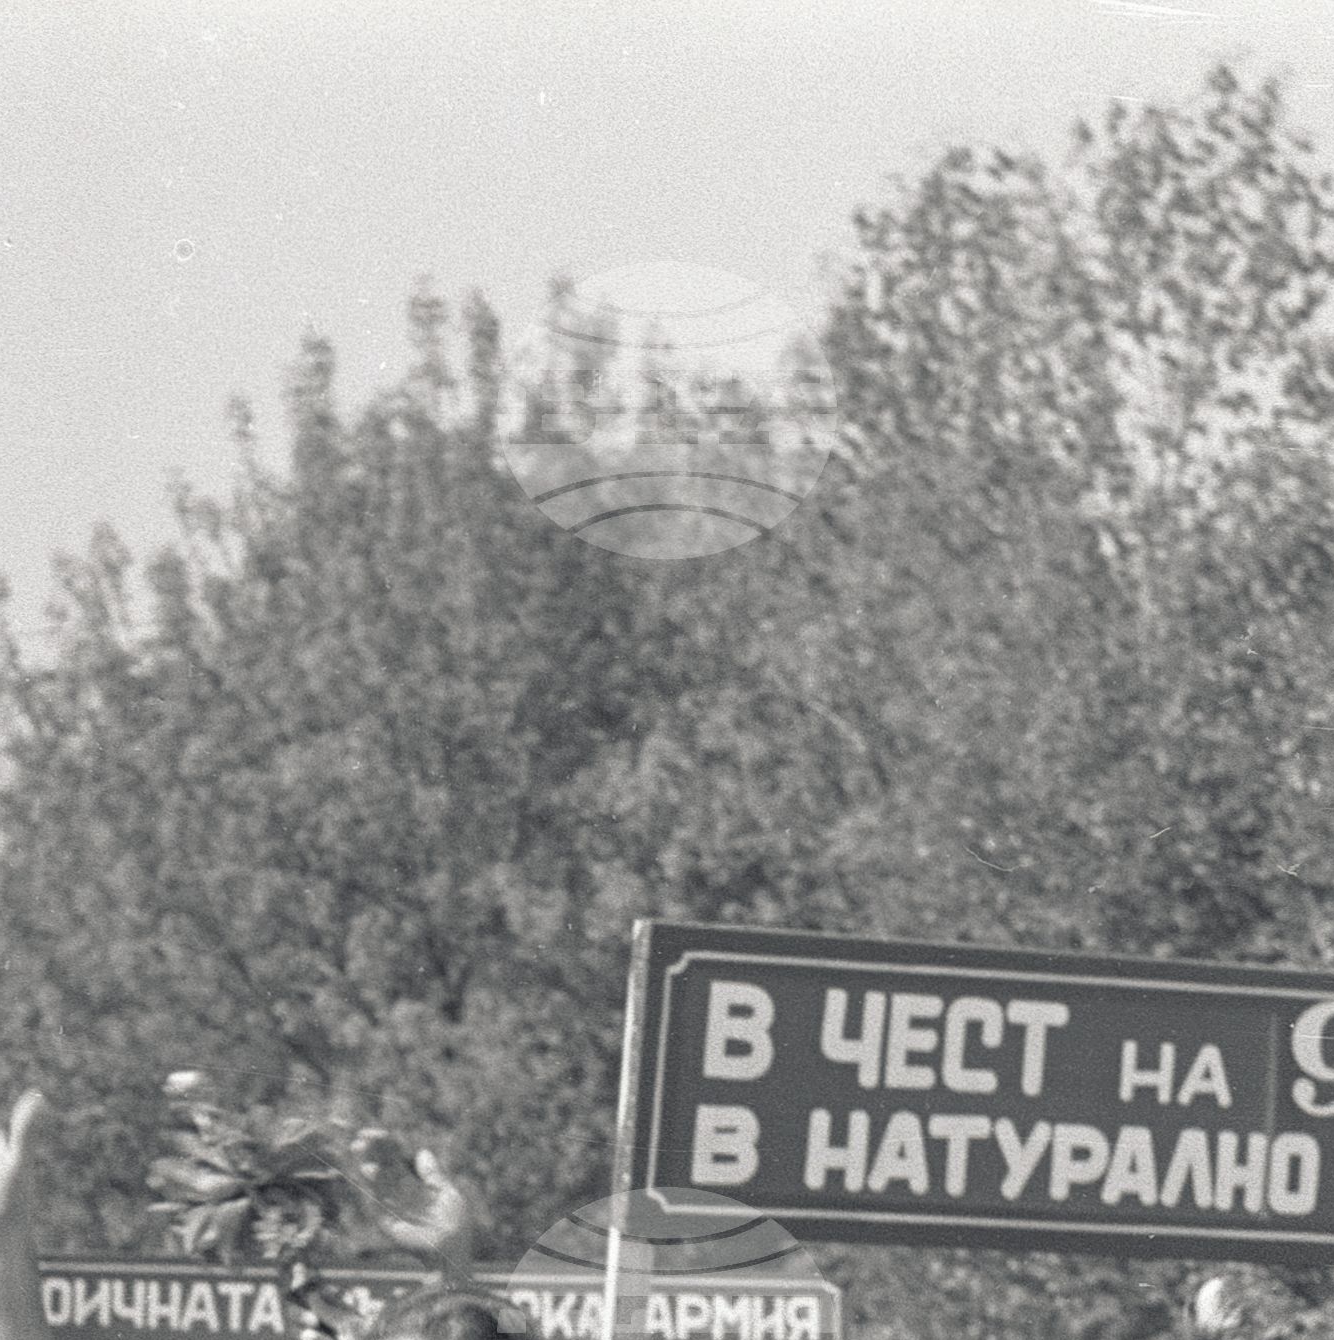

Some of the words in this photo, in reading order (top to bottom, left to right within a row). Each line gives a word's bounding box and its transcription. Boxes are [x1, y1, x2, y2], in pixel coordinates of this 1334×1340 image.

[703, 981, 775, 1081] В
[820, 988, 1070, 1097] ЧЕСТ
[1118, 1039, 1232, 1108] НА
[690, 1104, 760, 1186] В
[803, 1108, 1320, 1214] НАТУРАЛНО
